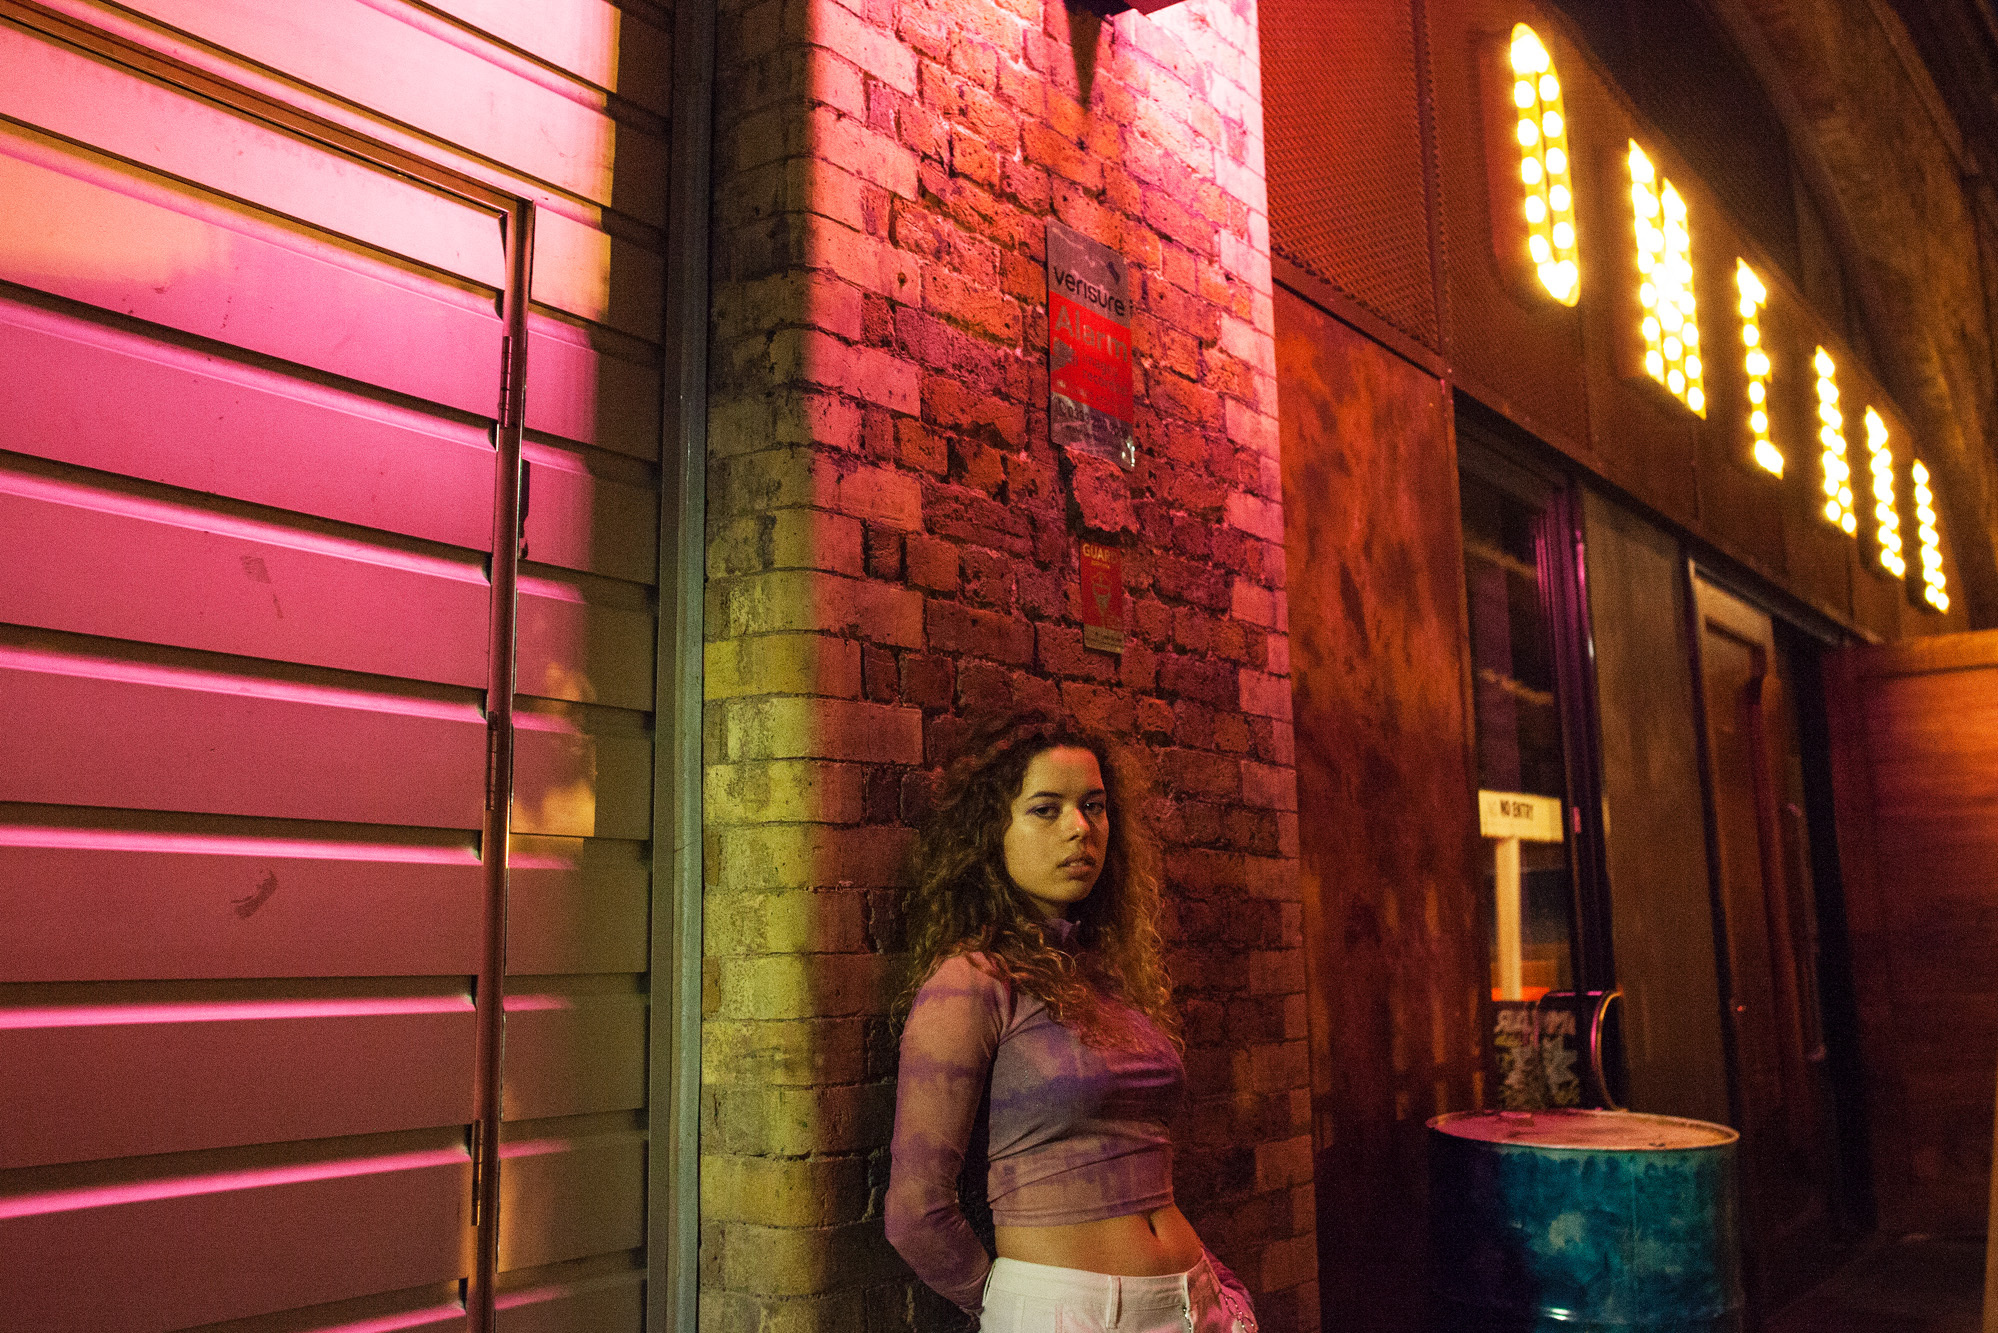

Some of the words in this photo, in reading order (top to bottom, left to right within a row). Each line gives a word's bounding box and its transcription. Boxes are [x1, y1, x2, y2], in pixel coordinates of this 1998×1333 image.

[1054, 266, 1126, 318] verisure
[1054, 304, 1128, 363] Alarm
[1500, 800, 1511, 817] NO
